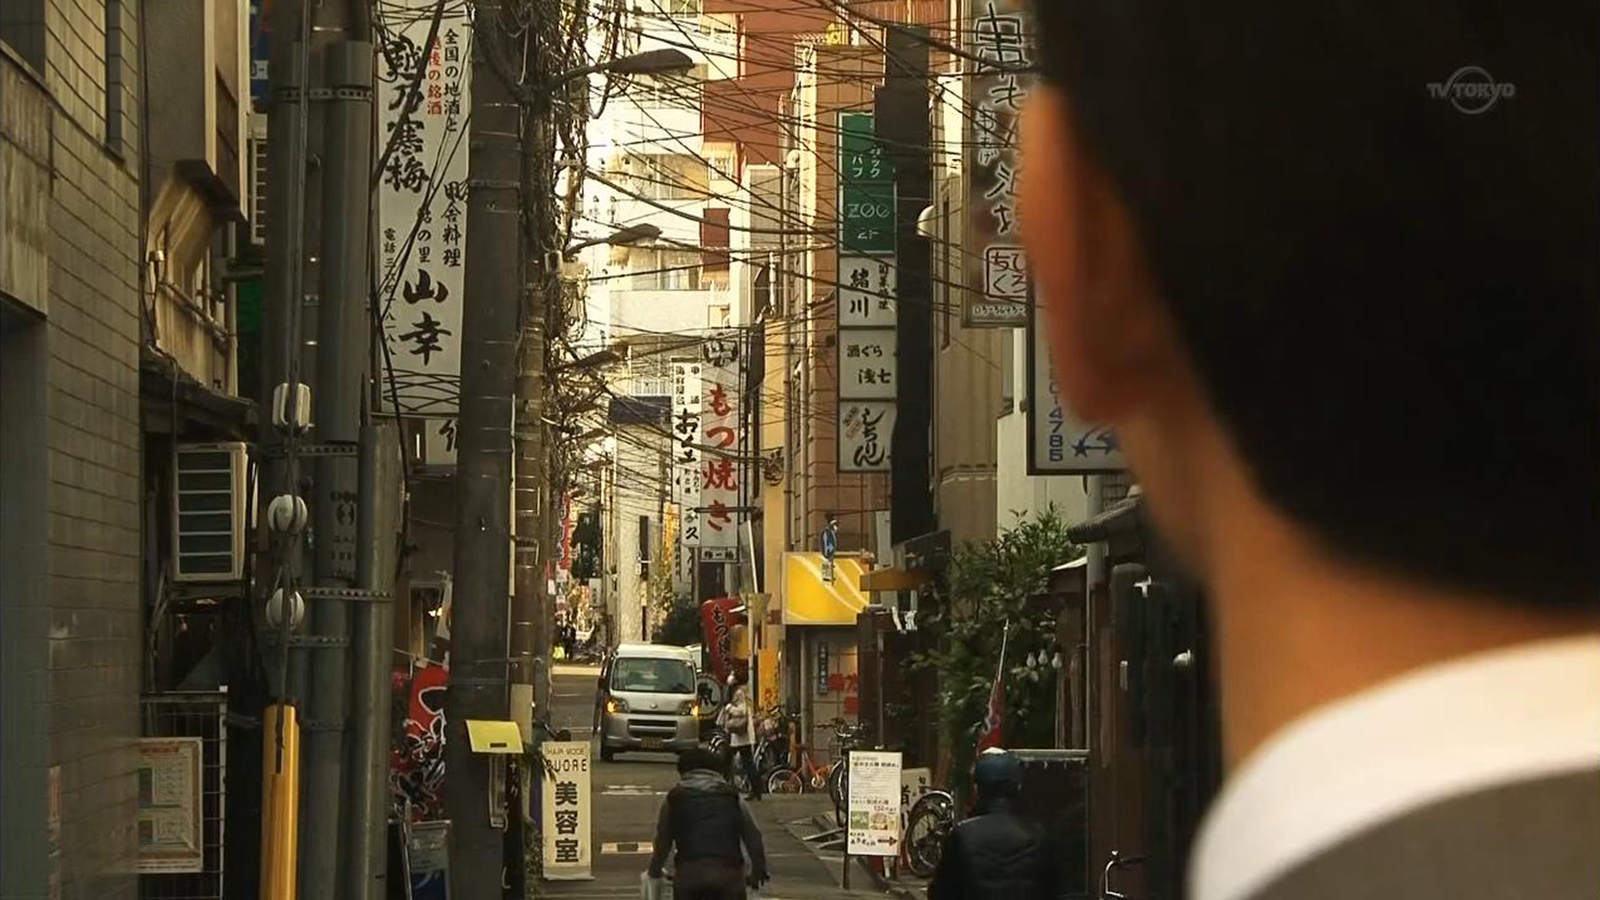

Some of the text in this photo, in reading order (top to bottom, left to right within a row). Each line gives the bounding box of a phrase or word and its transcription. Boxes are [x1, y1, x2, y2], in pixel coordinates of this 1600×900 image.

[443, 28, 460, 132] 全国の地酒と
[398, 268, 452, 366] 山幸
[847, 344, 883, 358] 酒ぐら
[702, 383, 738, 531] もつ焼き
[555, 781, 579, 863] 美容室
